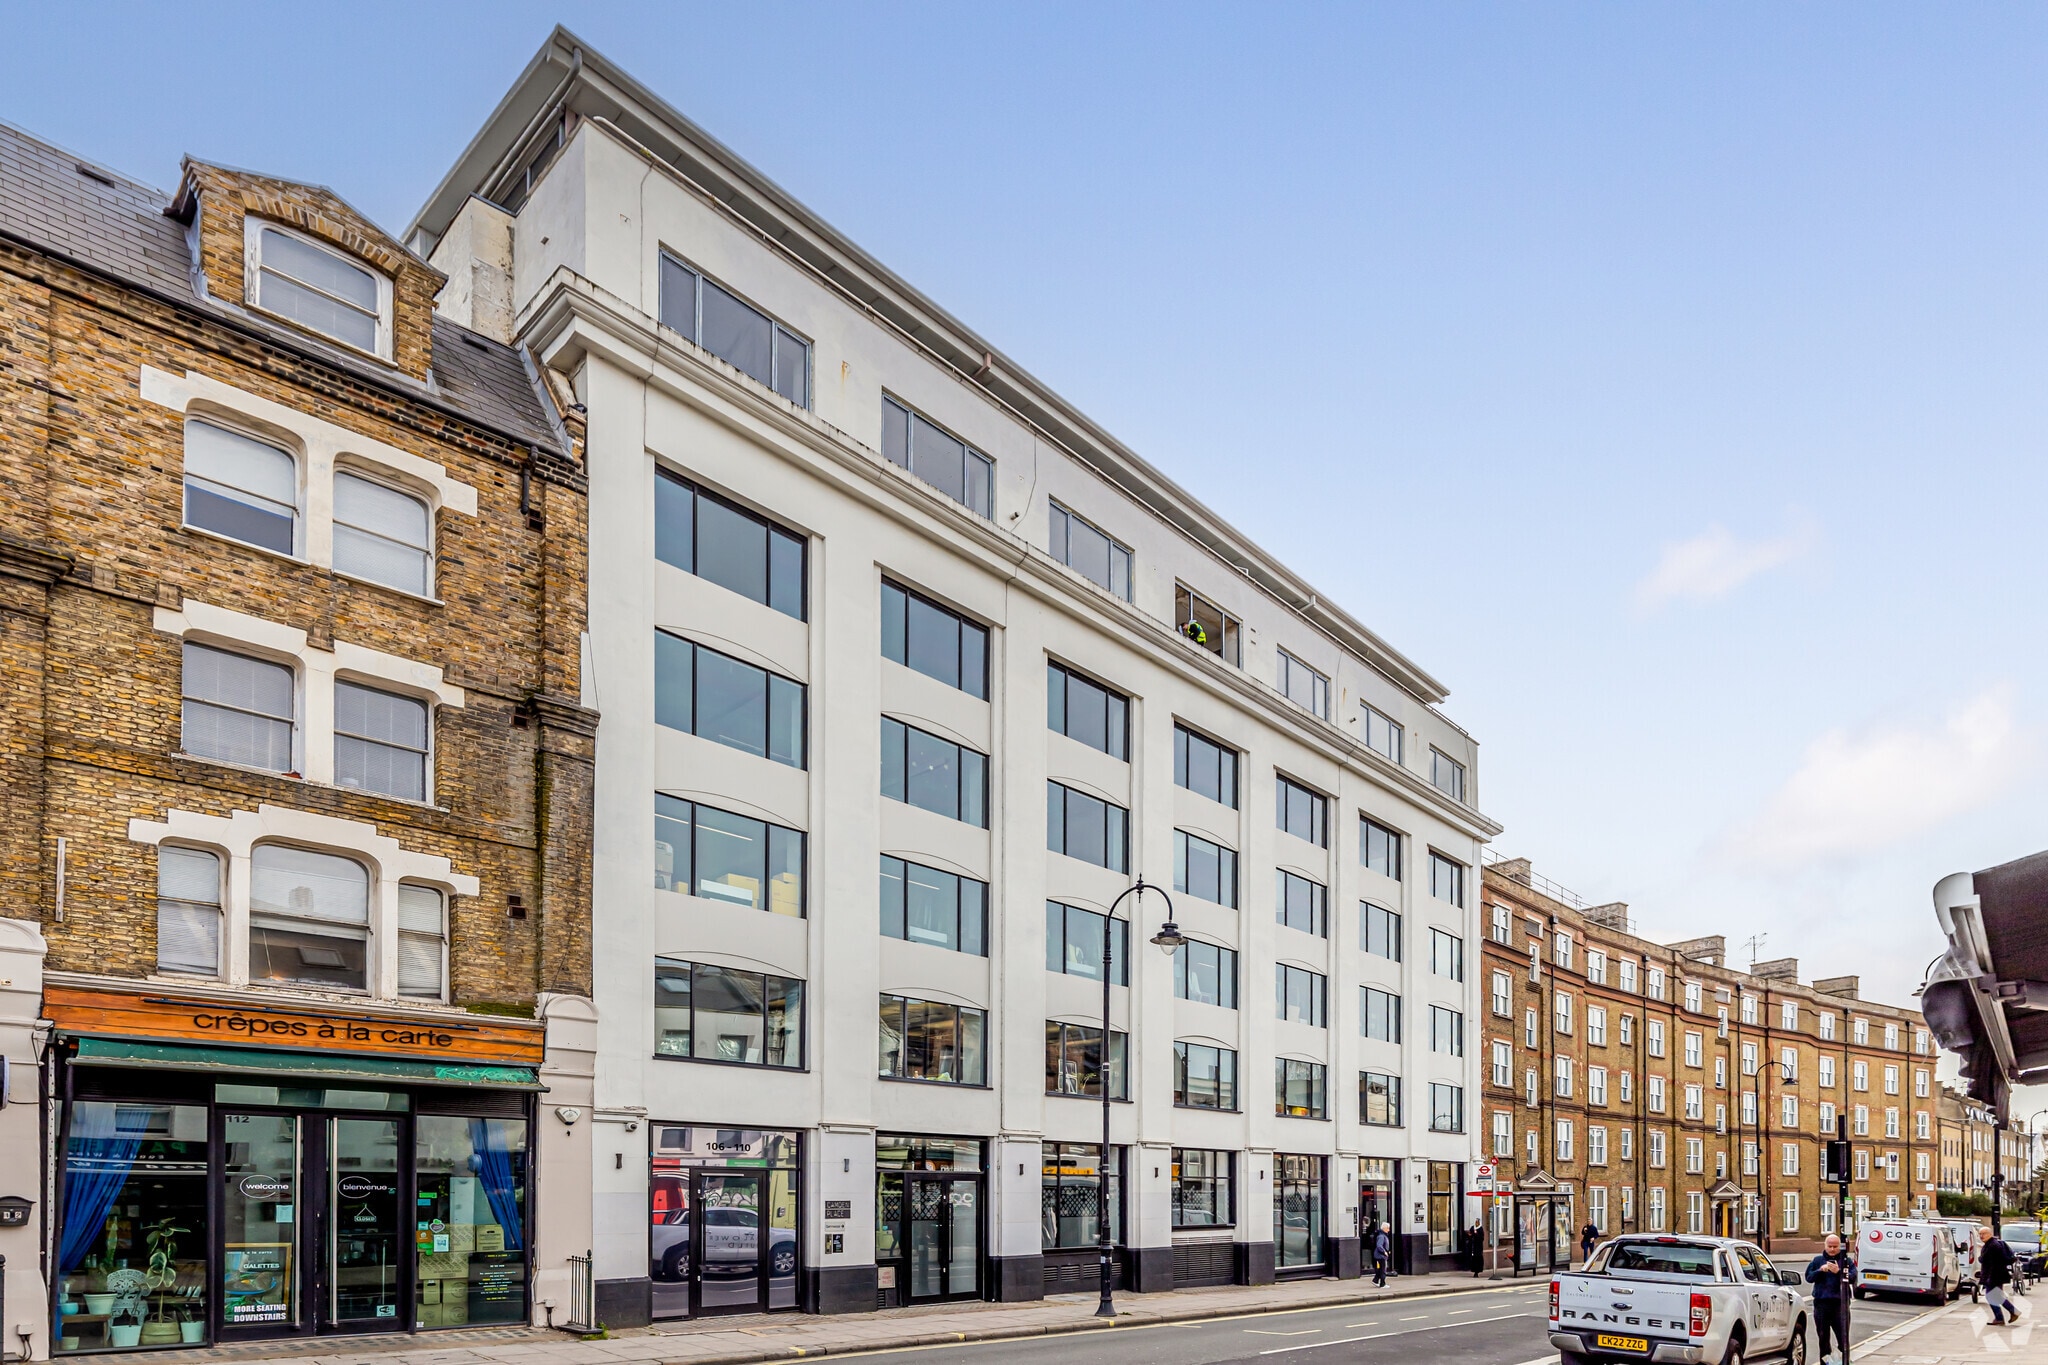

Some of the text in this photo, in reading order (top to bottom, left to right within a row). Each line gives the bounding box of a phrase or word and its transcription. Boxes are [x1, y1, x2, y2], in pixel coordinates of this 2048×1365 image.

[193, 1012, 454, 1048] crêpes à la carte
[226, 1115, 250, 1124] 112
[706, 1142, 725, 1151] 106
[734, 1143, 751, 1152] 110
[342, 1183, 388, 1191] bienvenue
[826, 1210, 845, 1218] PLACE
[1886, 1230, 1922, 1240] CORE
[234, 1303, 287, 1313] MORE SEATING
[234, 1312, 287, 1322] DOWNSTAIRS
[1562, 1309, 1686, 1331] RANGER
[1601, 1336, 1644, 1349] CK22 ZZG
